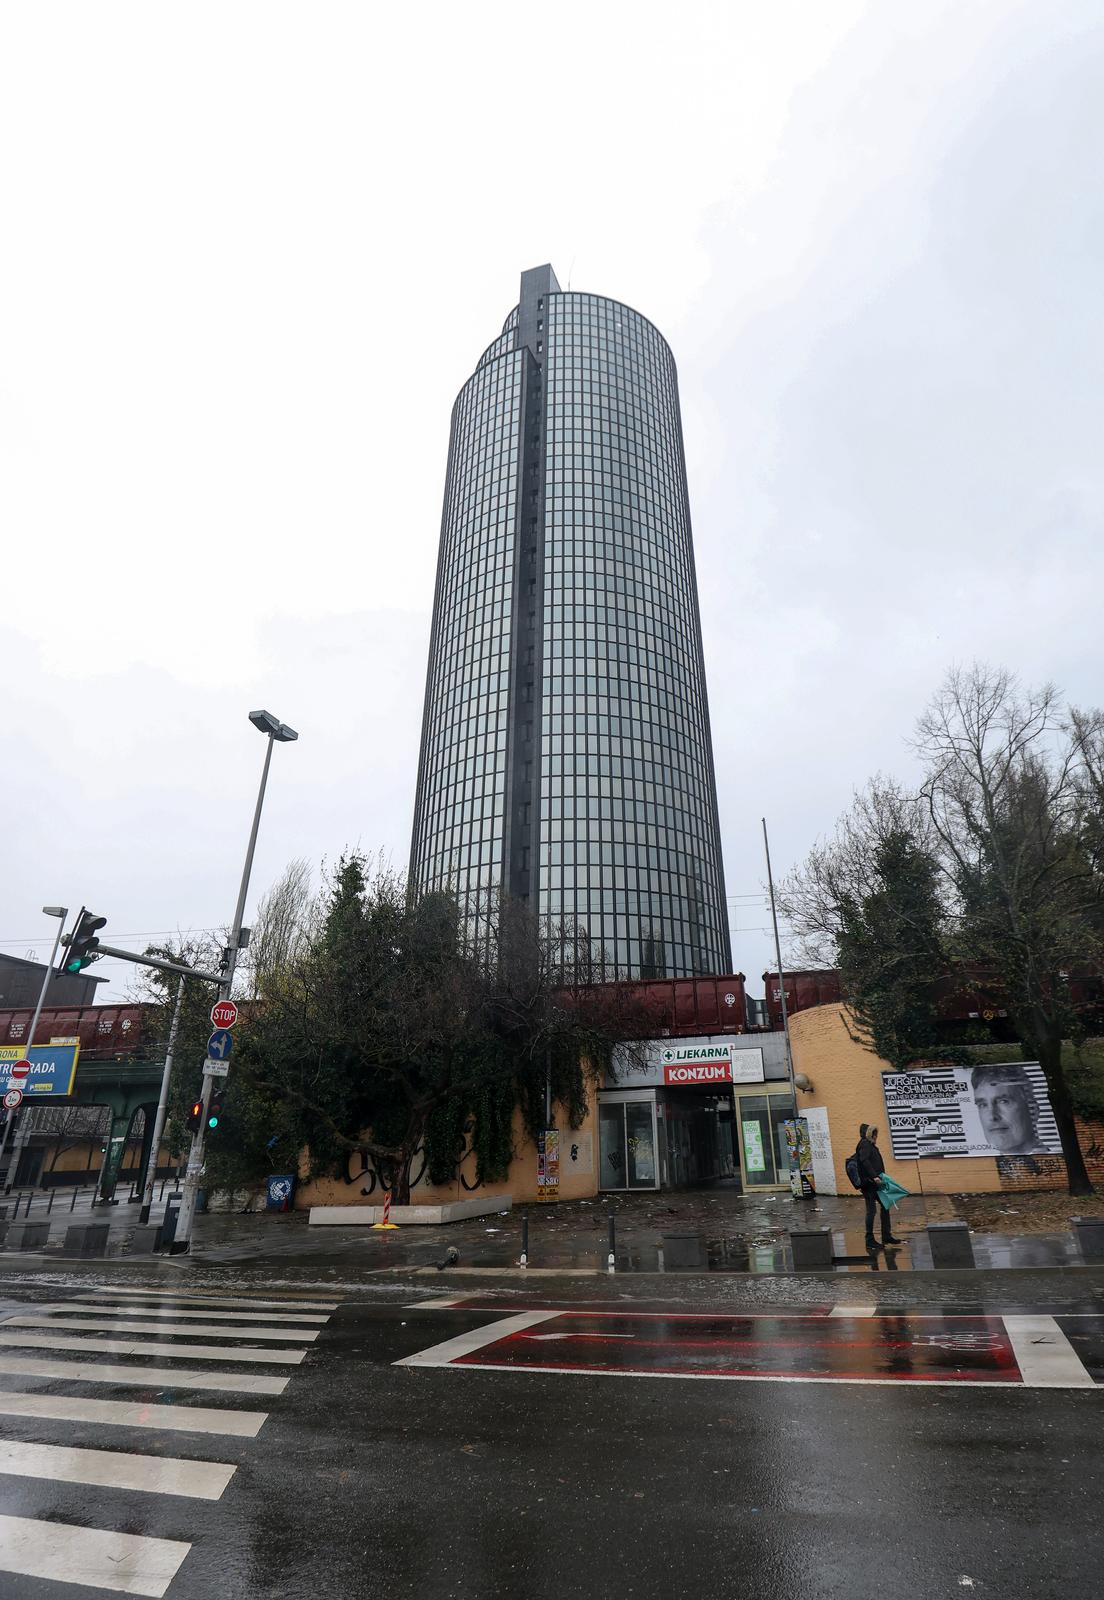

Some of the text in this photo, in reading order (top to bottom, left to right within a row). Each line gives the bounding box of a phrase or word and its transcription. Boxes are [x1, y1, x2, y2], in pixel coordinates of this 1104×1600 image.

[213, 1008, 236, 1021] STOP
[676, 1047, 729, 1060] LJEKARNA
[29, 1062, 56, 1074] RADA
[668, 1065, 726, 1082] KONZUM
[884, 1076, 923, 1087] JÜRGEN
[896, 1083, 968, 1095] SCHMIDHUBER
[919, 1092, 945, 1100] MODERN
[890, 1116, 929, 1127] DK2026
